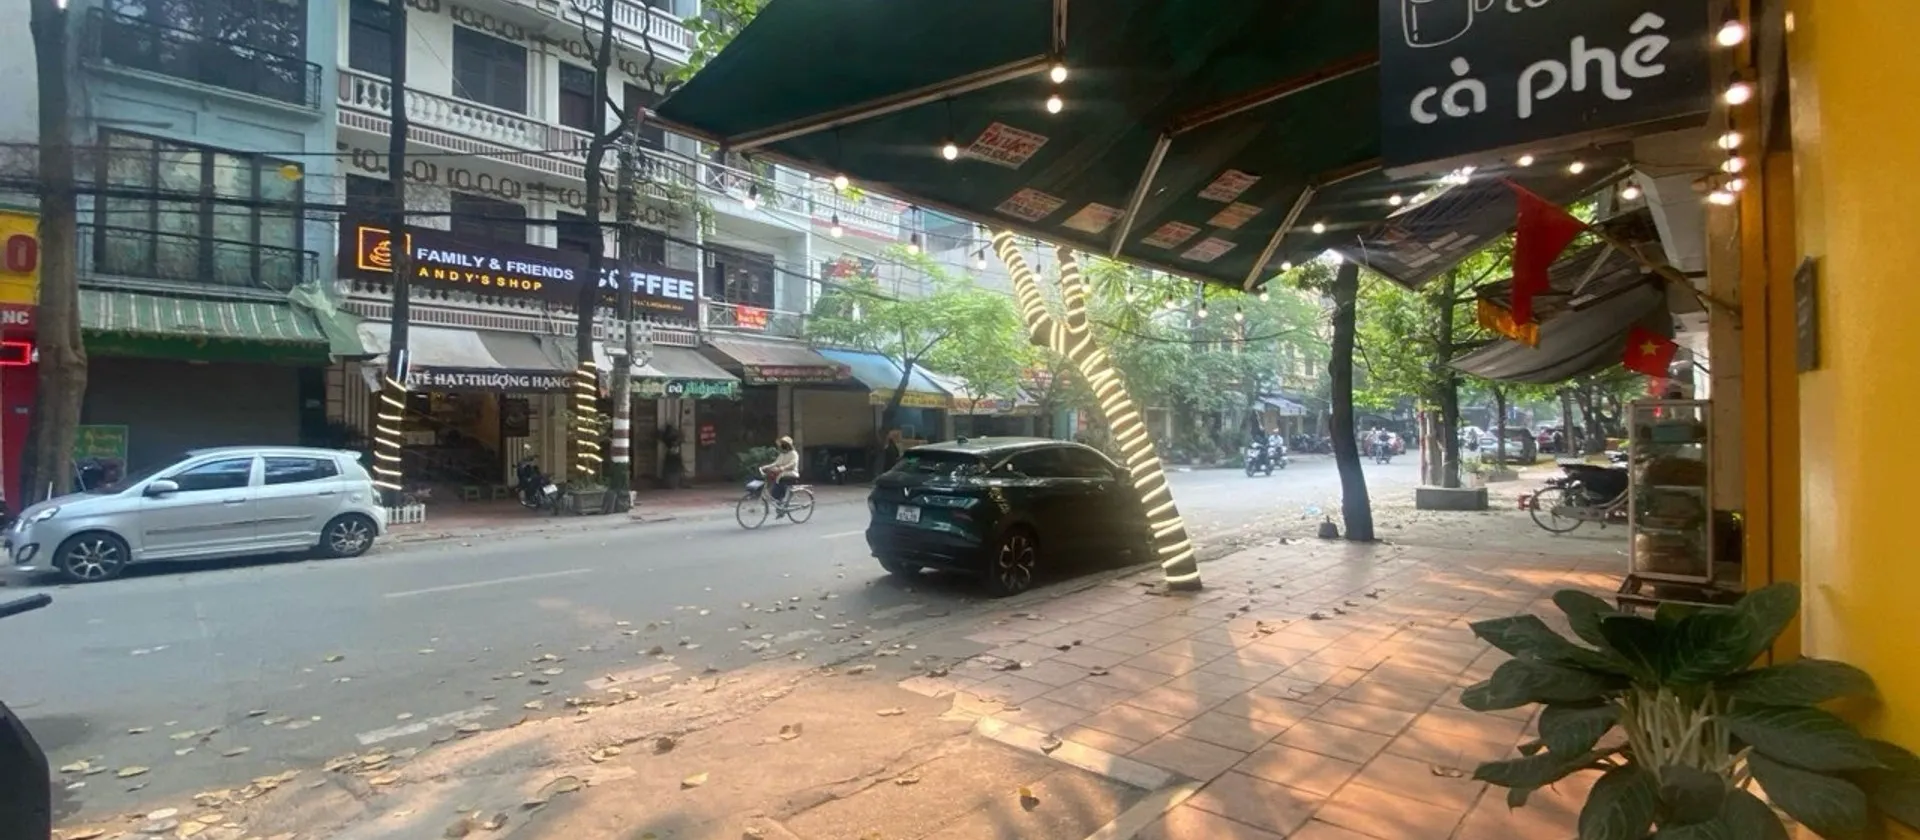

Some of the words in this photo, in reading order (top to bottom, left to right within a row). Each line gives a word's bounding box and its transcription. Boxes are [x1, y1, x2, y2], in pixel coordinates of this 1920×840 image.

[1410, 56, 1487, 124] cà
[1517, 12, 1670, 119] phê
[417, 248, 485, 268] FAMILY
[489, 258, 502, 270] &
[506, 261, 575, 280] FRIENDS
[418, 267, 491, 285] ANDY'S
[496, 277, 543, 291] SHOP
[469, 373, 529, 389] THƯỢNG
[532, 376, 571, 390] HẠNG
